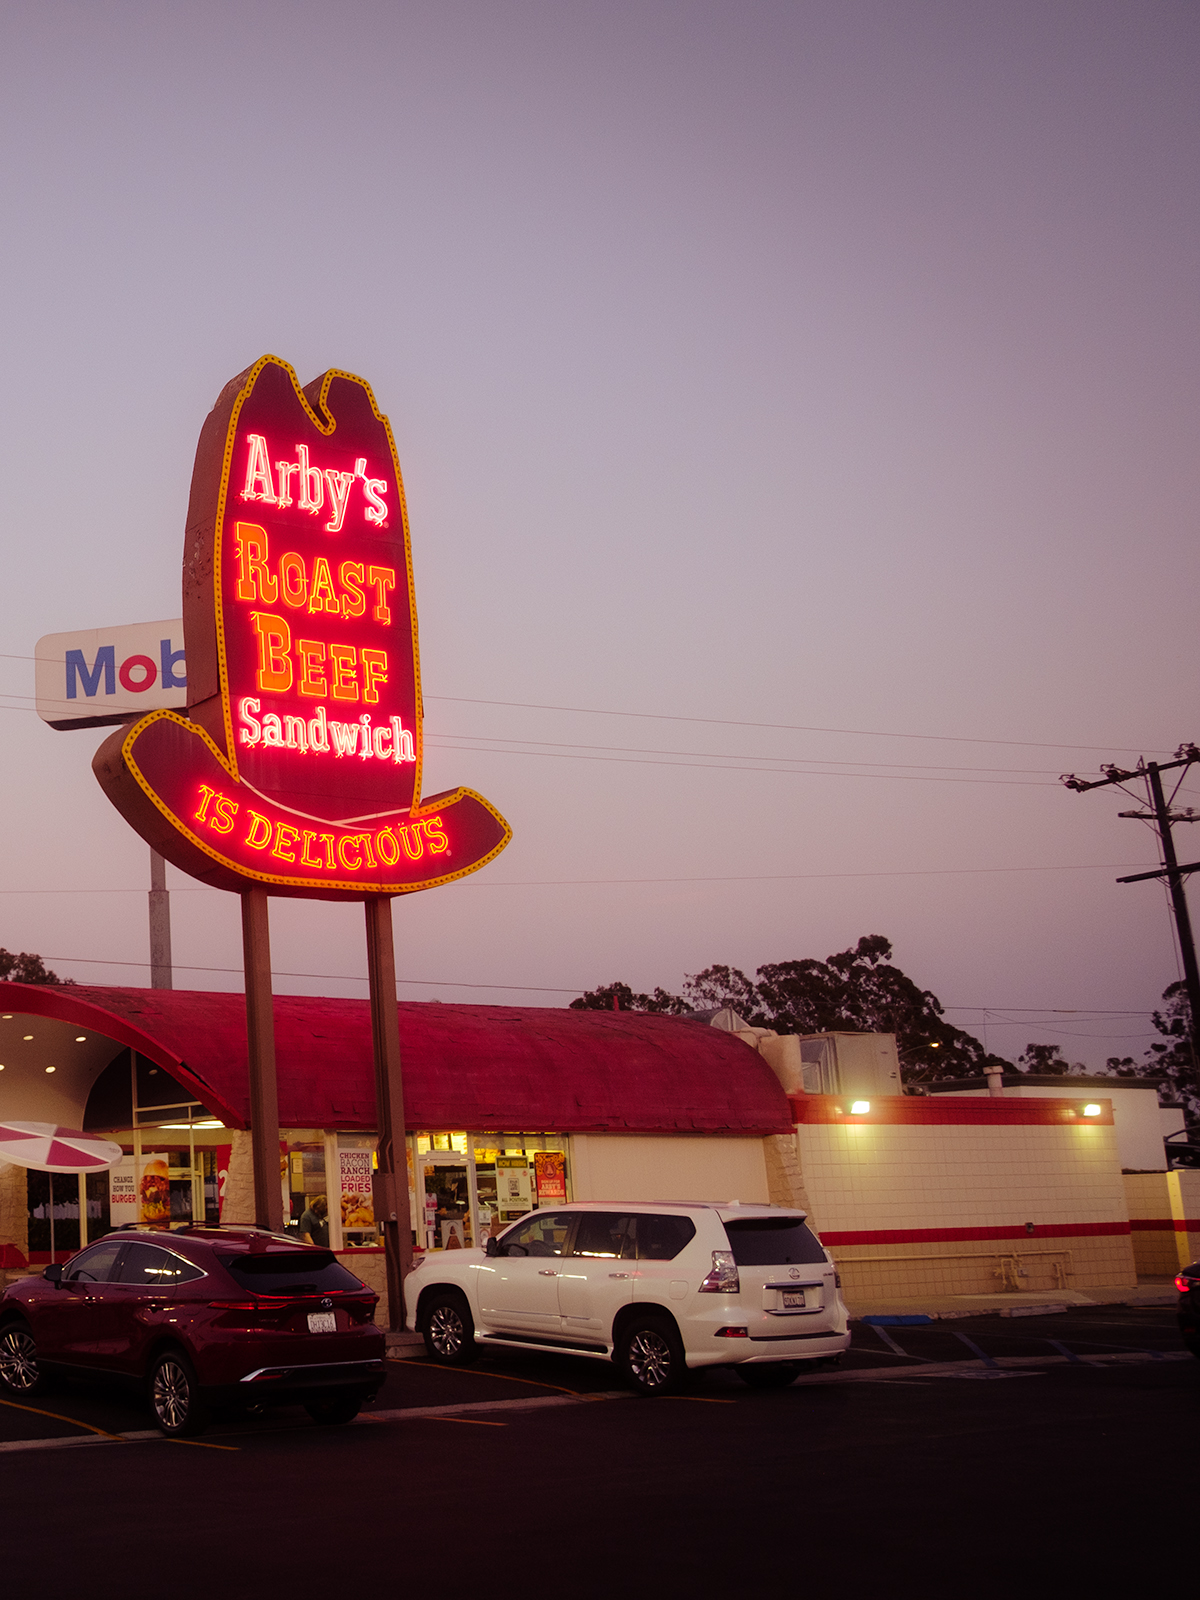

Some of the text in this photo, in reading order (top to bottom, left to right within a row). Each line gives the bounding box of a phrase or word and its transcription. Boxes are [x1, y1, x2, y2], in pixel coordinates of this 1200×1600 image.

[241, 434, 390, 532] Arby's
[234, 521, 395, 625] ROAST
[252, 611, 389, 705] BEEF
[238, 697, 417, 764] Sandwich
[194, 783, 449, 872] IS DELICIOUS
[340, 1158, 370, 1167] BACON
[340, 1167, 370, 1175] RANCH
[340, 1175, 371, 1183] LOADED
[112, 1194, 137, 1203] BURGER
[341, 1183, 371, 1193] FRIES
